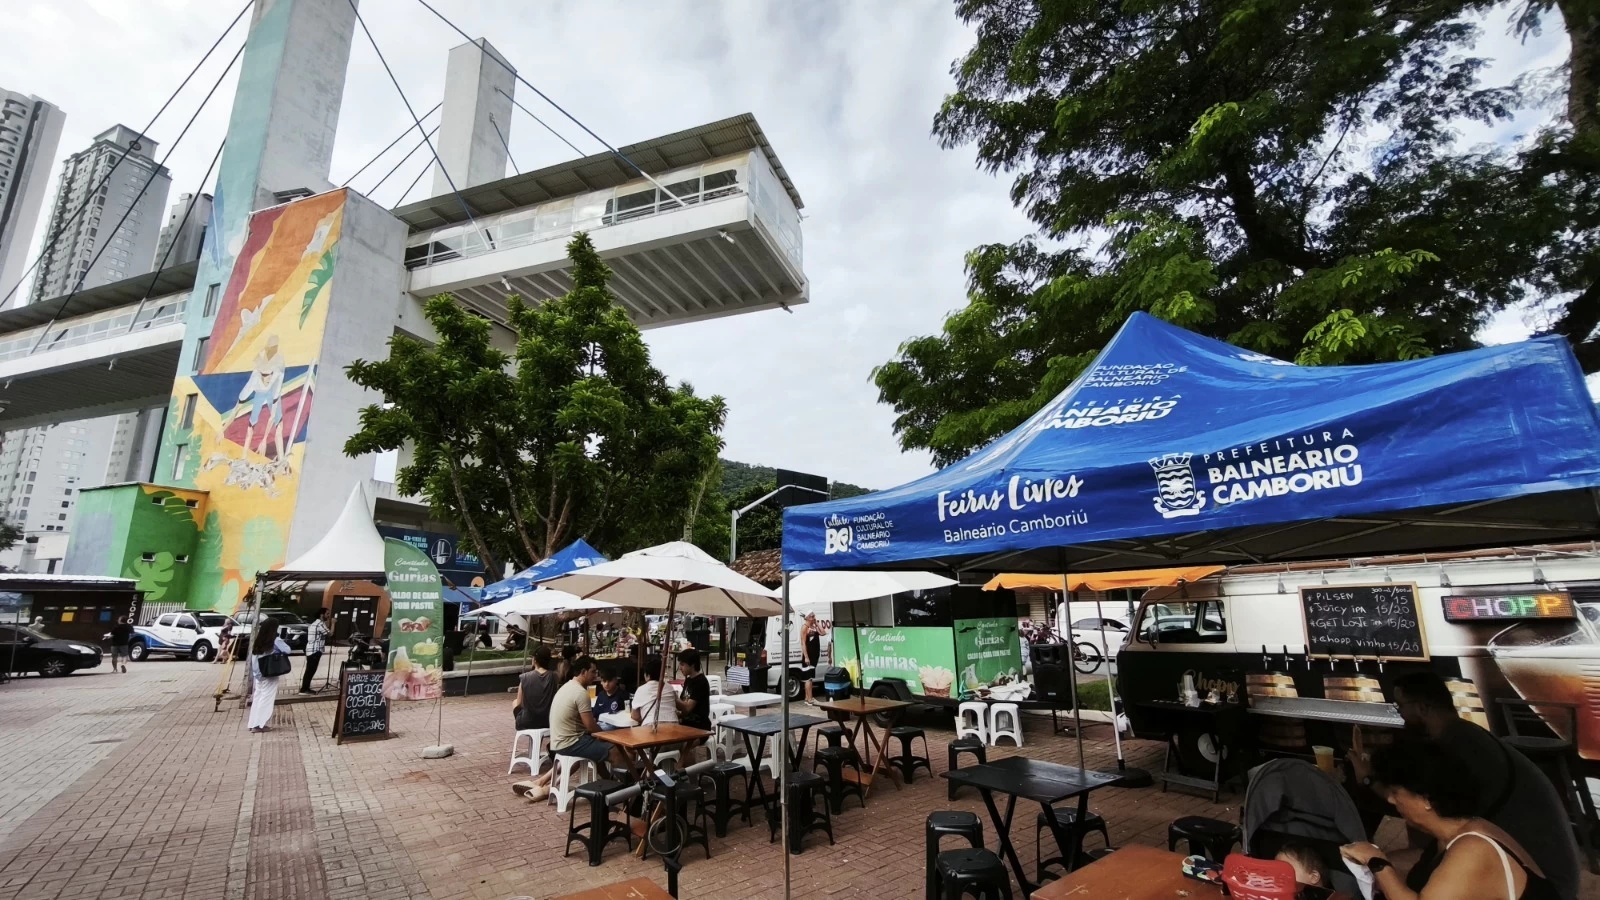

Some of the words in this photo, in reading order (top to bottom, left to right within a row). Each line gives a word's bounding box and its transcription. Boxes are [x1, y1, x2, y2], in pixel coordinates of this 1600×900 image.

[1168, 366, 1189, 374] DE
[1071, 394, 1182, 407] FEITURA
[1204, 428, 1354, 463] PREFEITURA
[1208, 444, 1359, 484] BALNEÁRIO
[1213, 463, 1363, 504] CAMBORIÚ
[937, 483, 1004, 522] Feiras
[1008, 474, 1083, 511] Livres
[853, 512, 885, 523] FUNDAÇÃO
[856, 522, 885, 532] CULTURAL
[885, 520, 894, 528] DE
[944, 523, 1006, 543] Balneário
[1010, 509, 1088, 534] Camboriú
[857, 530, 890, 541] BALNEÁRIO
[856, 539, 890, 550] CAMBORIÚ
[389, 570, 437, 583] Gurias
[1450, 597, 1562, 618] CHOPP
[869, 630, 905, 644] Cantinho
[975, 635, 1004, 646] Gurias
[864, 651, 917, 671] Gurias
[348, 683, 364, 694] HOT
[364, 683, 383, 694] DOG
[346, 695, 386, 708] COSTELA
